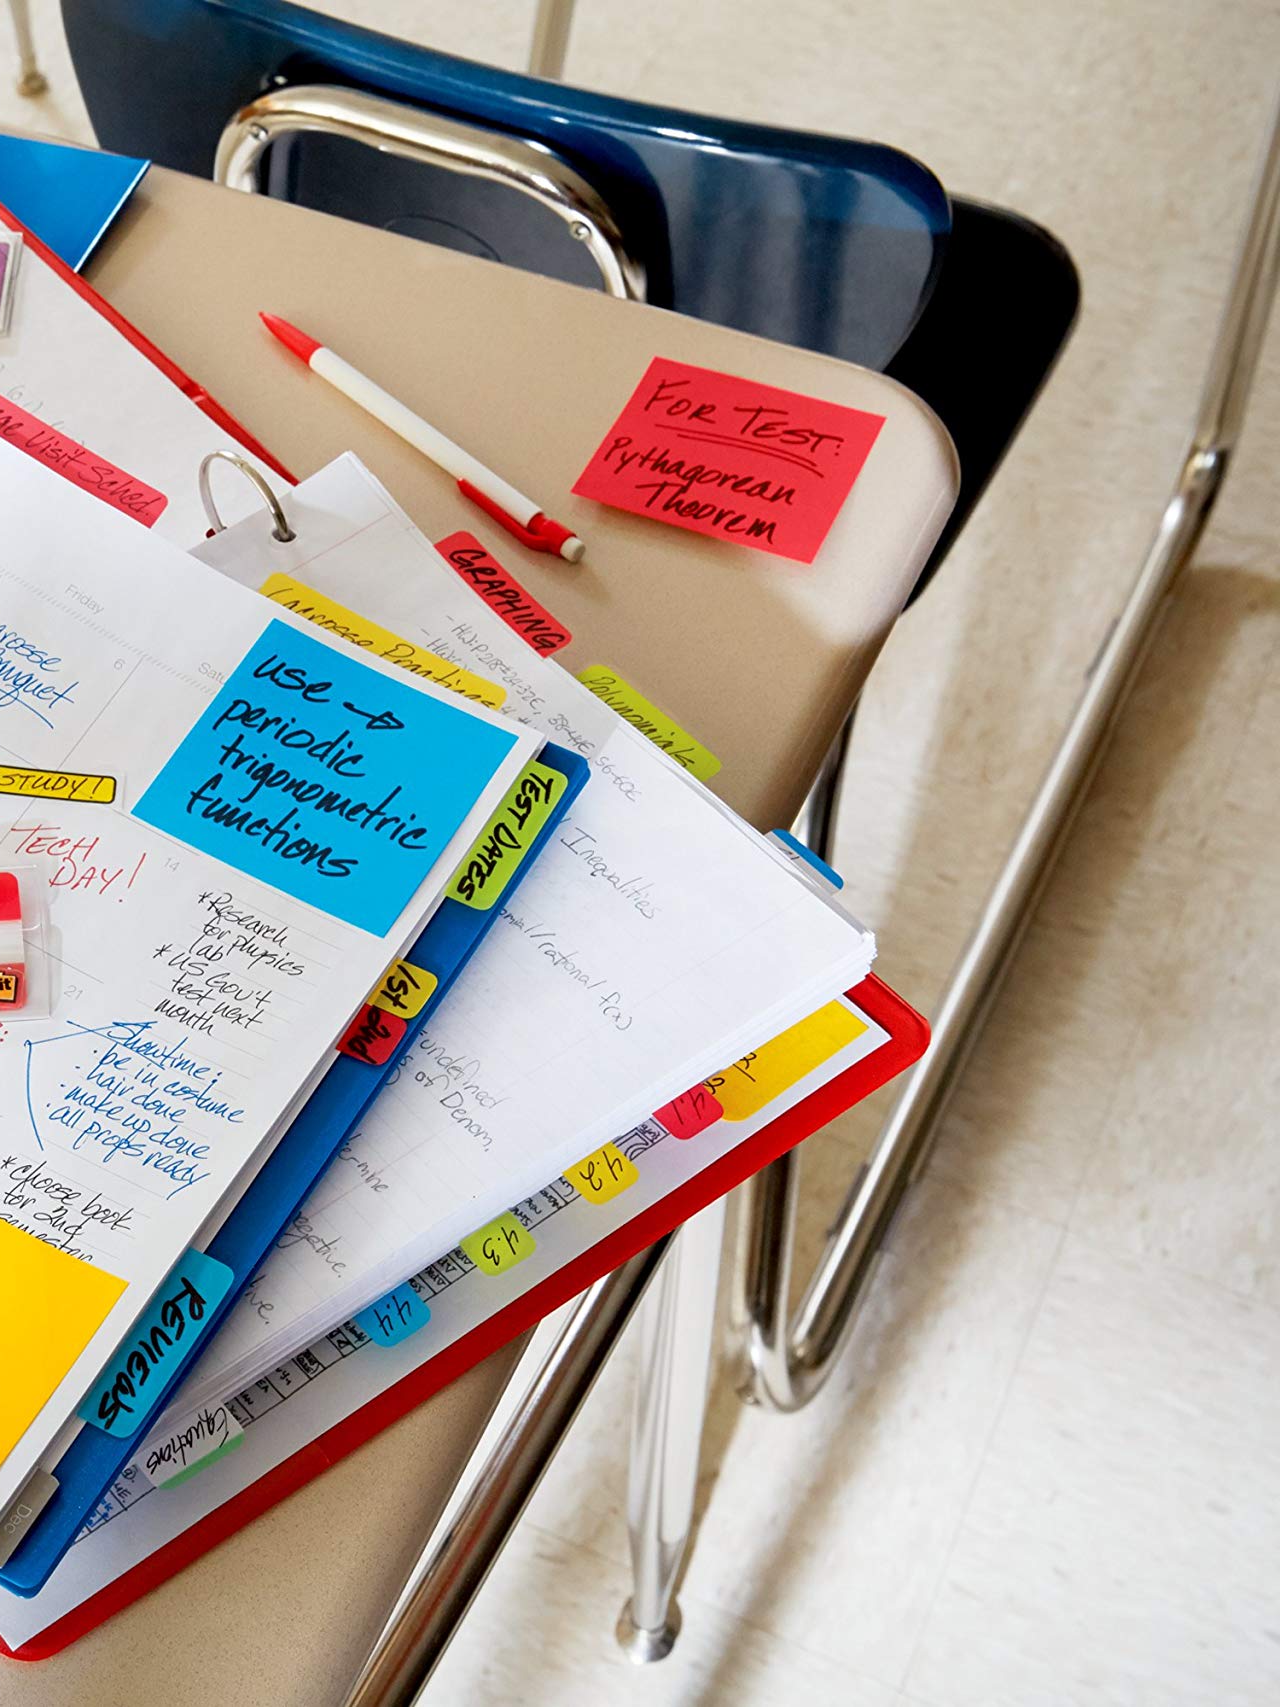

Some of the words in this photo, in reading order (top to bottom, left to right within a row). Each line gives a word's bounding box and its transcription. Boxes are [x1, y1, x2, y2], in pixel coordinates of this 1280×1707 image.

[644, 379, 717, 425] FOR
[26, 431, 88, 469] Visit
[77, 465, 161, 516] Sched.
[604, 437, 796, 505] Pythagorean
[634, 481, 777, 544] Theorem
[64, 583, 104, 615] Friday
[449, 549, 563, 652] GRAPHING
[113, 658, 126, 671] 6
[253, 654, 331, 704] use
[212, 698, 365, 779] periodic
[219, 734, 427, 850] trigonometric
[507, 772, 553, 830] TEST
[10, 825, 99, 860] TECH
[186, 773, 359, 878] functions
[49, 853, 146, 903] DAY!
[164, 857, 180, 872] 14
[456, 821, 521, 902] DATES
[559, 826, 657, 920] Inequalities
[189, 935, 224, 962] lab
[203, 916, 231, 940] for
[226, 935, 304, 976] physics
[207, 892, 289, 948] Research
[63, 985, 83, 1000] 21
[168, 952, 209, 976] US
[205, 972, 273, 1009] Gov't
[172, 972, 216, 1006] test
[212, 1001, 264, 1029] next
[380, 963, 420, 1010] 1st
[154, 998, 216, 1037] month
[346, 1004, 392, 1064] 2nd
[87, 1065, 133, 1096] hair
[132, 1088, 184, 1124] done
[100, 1043, 127, 1071] be
[135, 1063, 155, 1087] in
[163, 1081, 245, 1124] costume
[669, 1090, 706, 1124] 4.1
[65, 1084, 120, 1120] make
[122, 1113, 151, 1140] up
[149, 1125, 210, 1160] done
[49, 1105, 82, 1129] all
[73, 1121, 143, 1163] props
[142, 1152, 210, 1200] ready
[579, 1151, 624, 1191] 4.2
[1, 1184, 36, 1211] for
[10, 1161, 82, 1206] choose
[81, 1193, 133, 1232] book
[482, 1219, 520, 1266] 4.3
[377, 1295, 412, 1337] 4.4
[97, 1276, 208, 1431] REVIEWS
[146, 1404, 230, 1475] Equations
[4, 1504, 32, 1535] Dec
